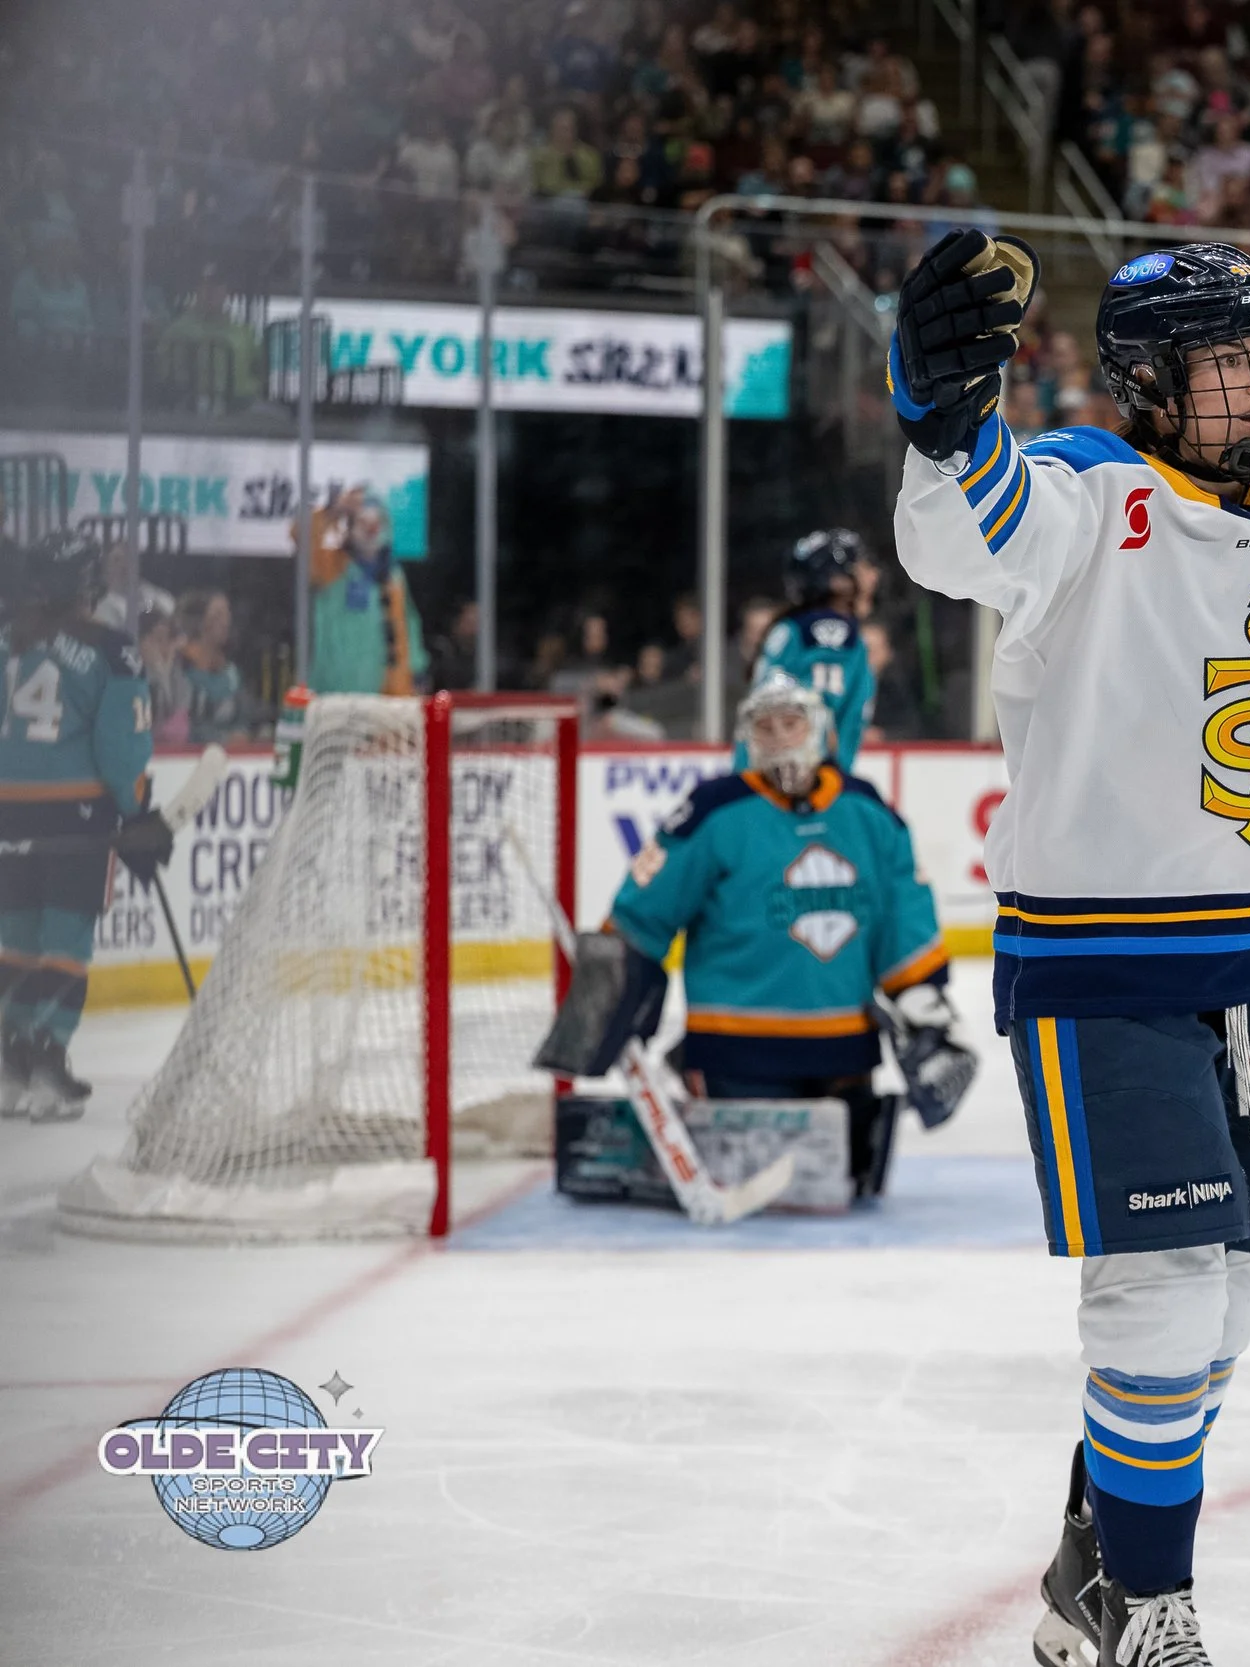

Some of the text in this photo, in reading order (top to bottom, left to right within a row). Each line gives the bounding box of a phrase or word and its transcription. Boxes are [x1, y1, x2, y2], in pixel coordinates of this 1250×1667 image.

[1113, 258, 1167, 282] Royale
[388, 331, 554, 383] YORK
[91, 472, 229, 517] YORK
[1128, 1180, 1233, 1211] Shark NINJA
